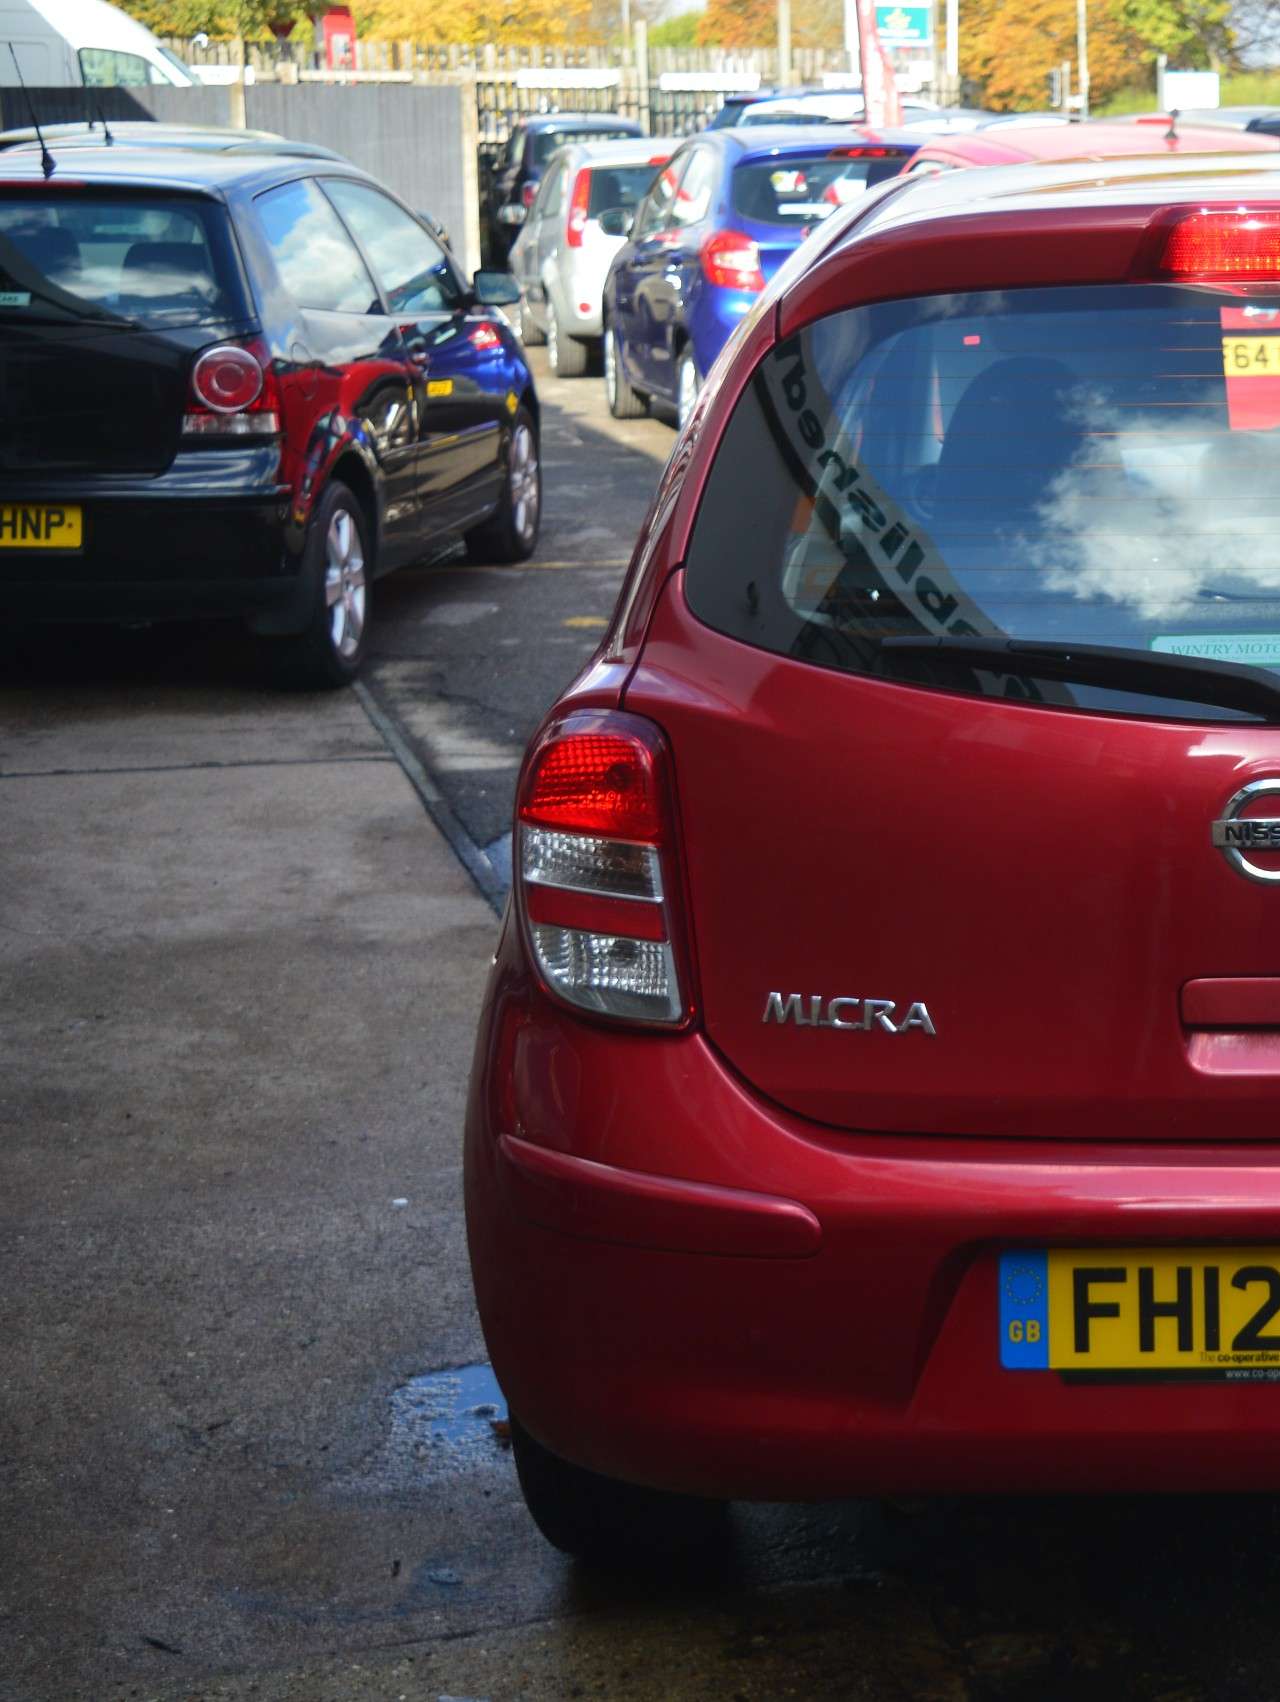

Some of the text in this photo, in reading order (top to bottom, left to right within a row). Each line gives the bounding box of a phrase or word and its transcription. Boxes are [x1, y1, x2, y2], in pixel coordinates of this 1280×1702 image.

[1223, 344, 1268, 369] 64
[0, 508, 65, 539] HNP
[762, 991, 937, 1035] MICRA
[1008, 1319, 1041, 1343] GB
[1200, 1351, 1217, 1362] The
[1217, 1351, 1280, 1363] co-operative
